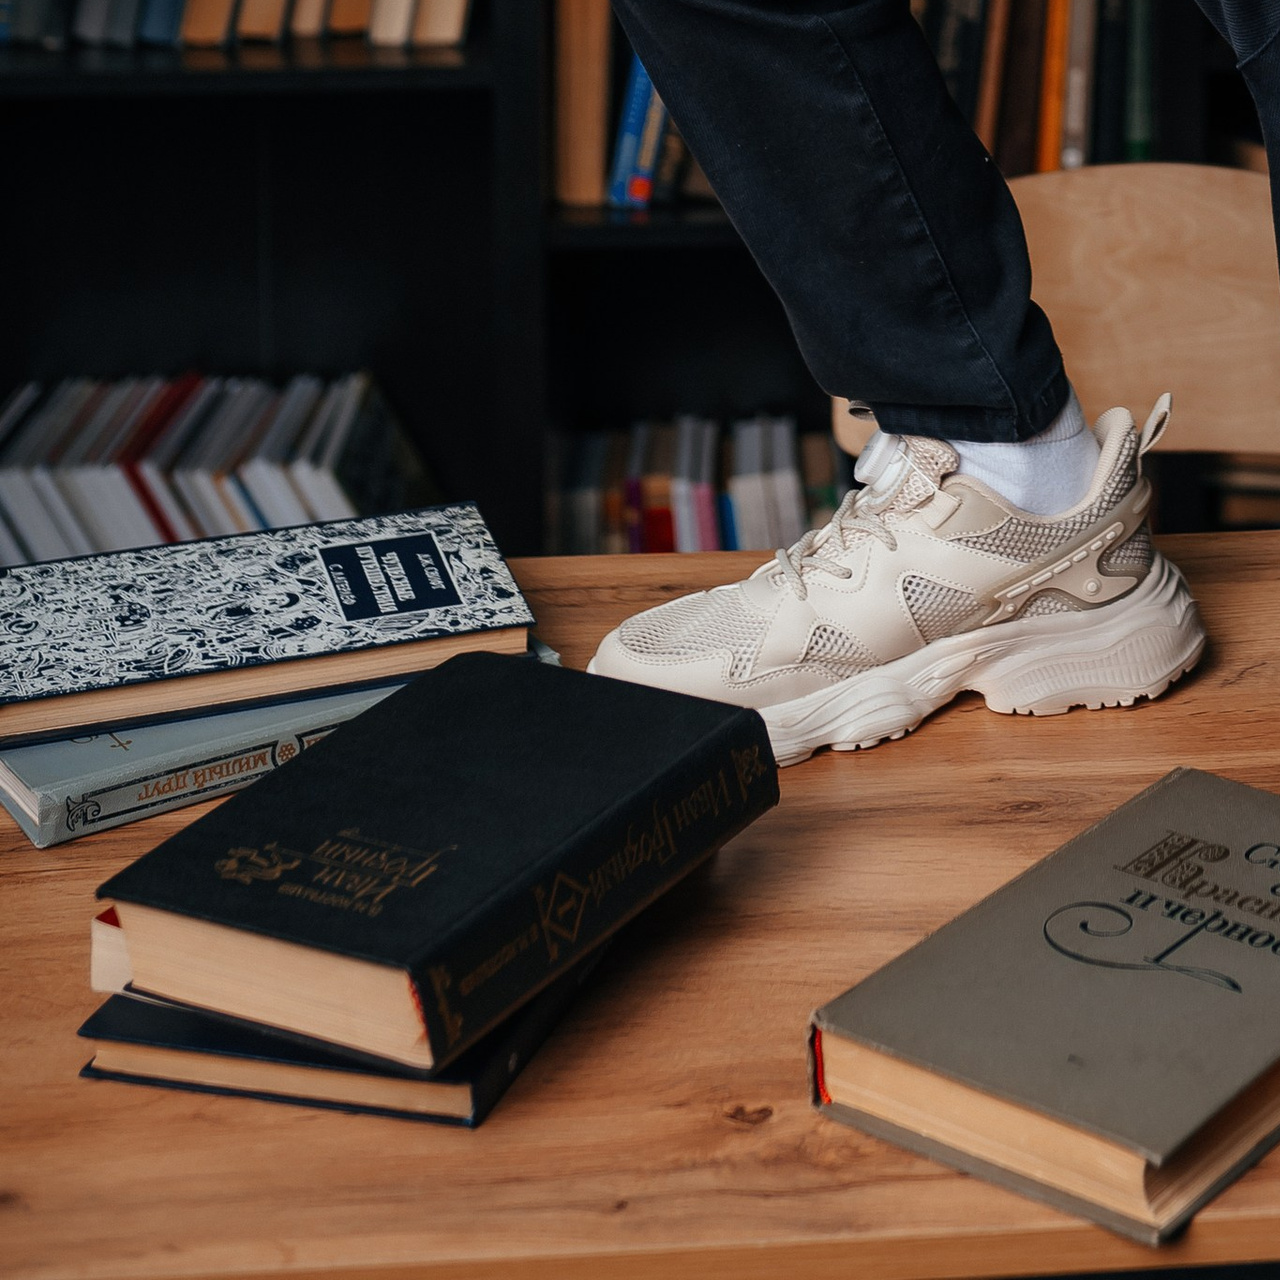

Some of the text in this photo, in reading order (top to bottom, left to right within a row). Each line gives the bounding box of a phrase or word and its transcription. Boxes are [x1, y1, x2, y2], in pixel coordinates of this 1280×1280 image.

[354, 545, 399, 614] ПУТЕШЕСТВИЯ
[380, 551, 417, 602] ЧУДЕСНЫЕ
[136, 750, 269, 802] МИЛЫЙ ДРУГ
